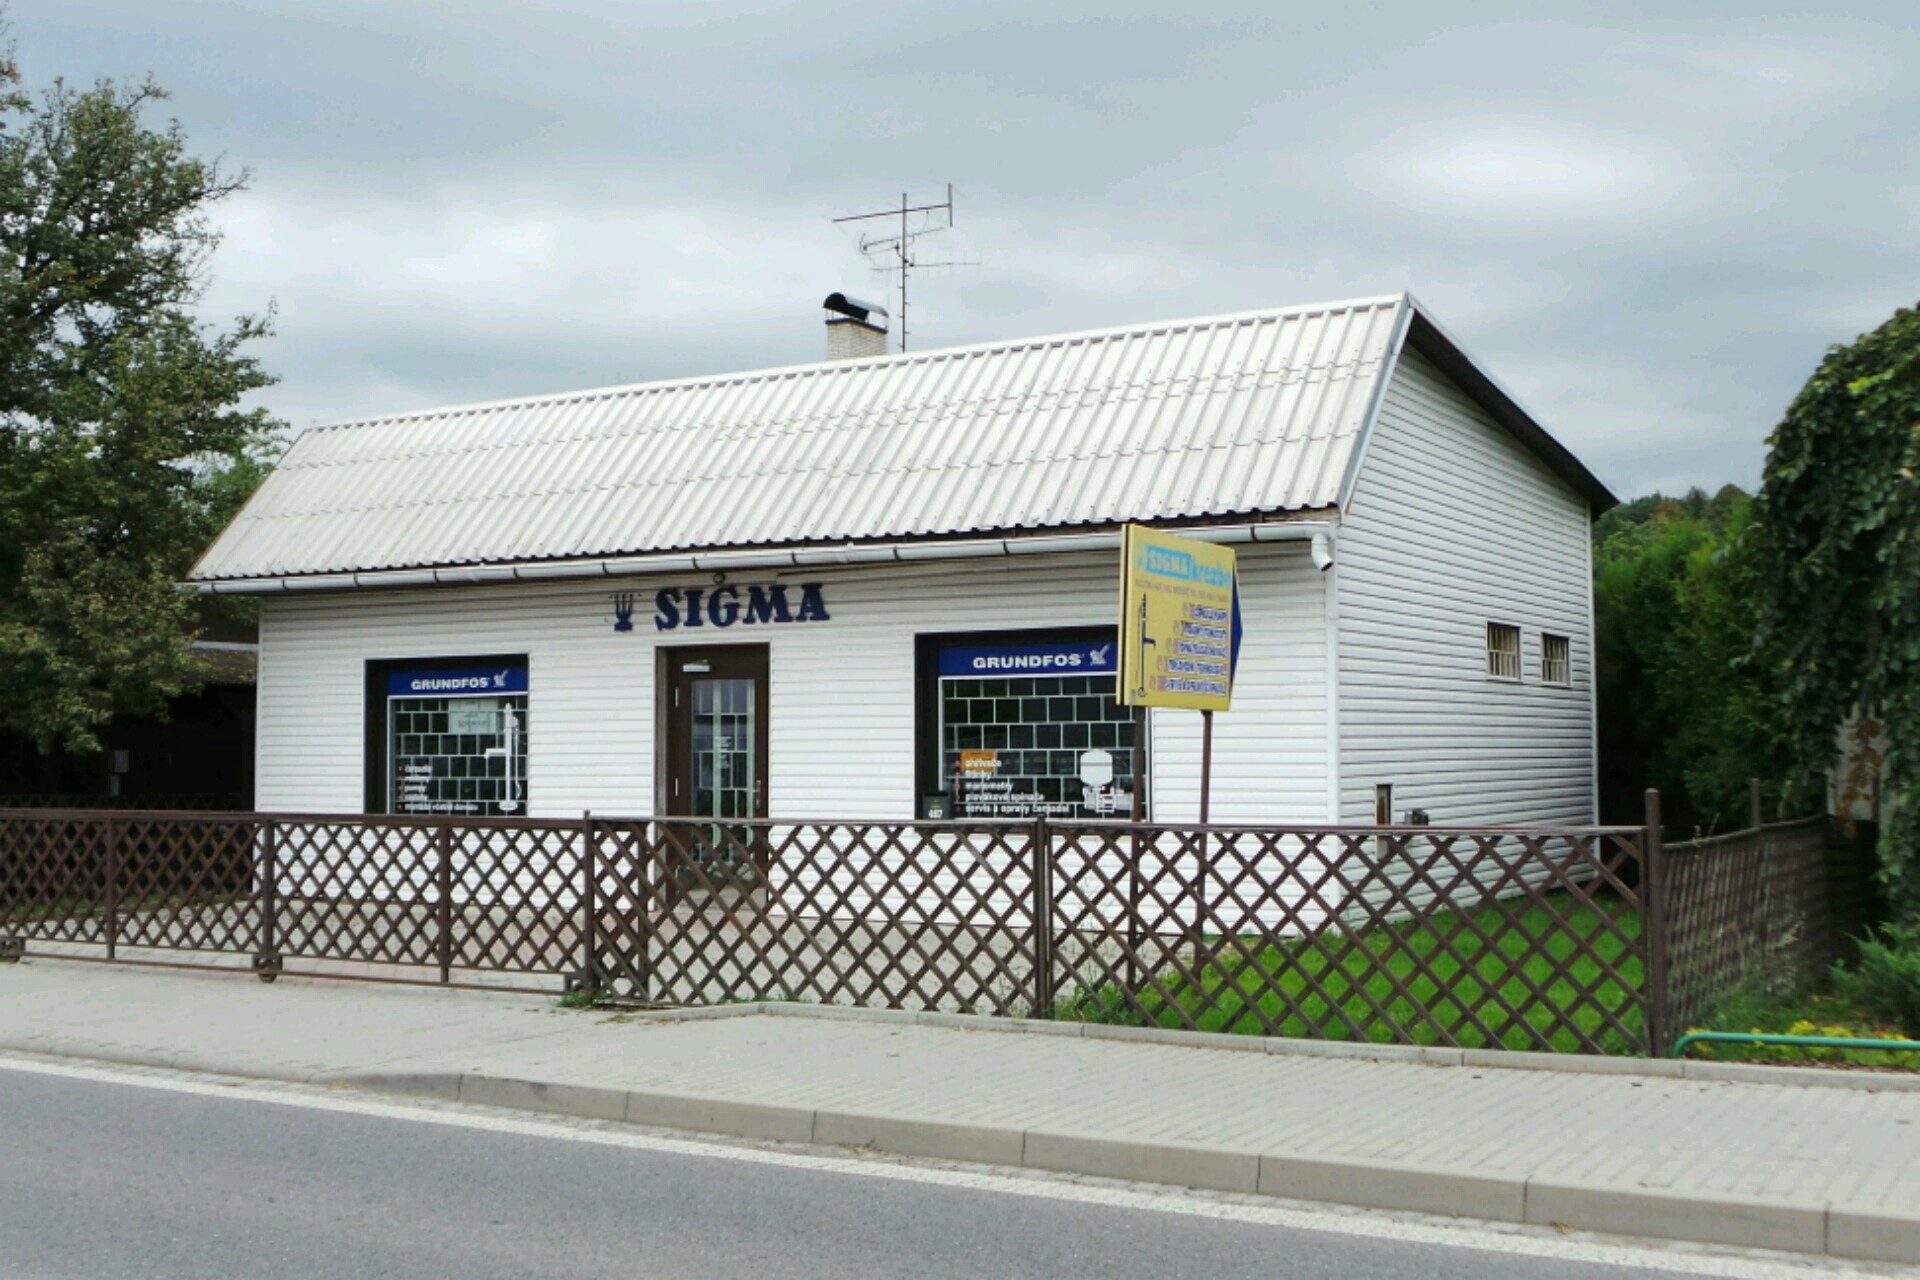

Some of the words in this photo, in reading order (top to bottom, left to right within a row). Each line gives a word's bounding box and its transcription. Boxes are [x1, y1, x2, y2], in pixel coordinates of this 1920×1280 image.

[654, 582, 831, 631] SIGMA
[972, 653, 1082, 669] GRUNDFOS
[410, 677, 489, 690] GRUNDFOS
